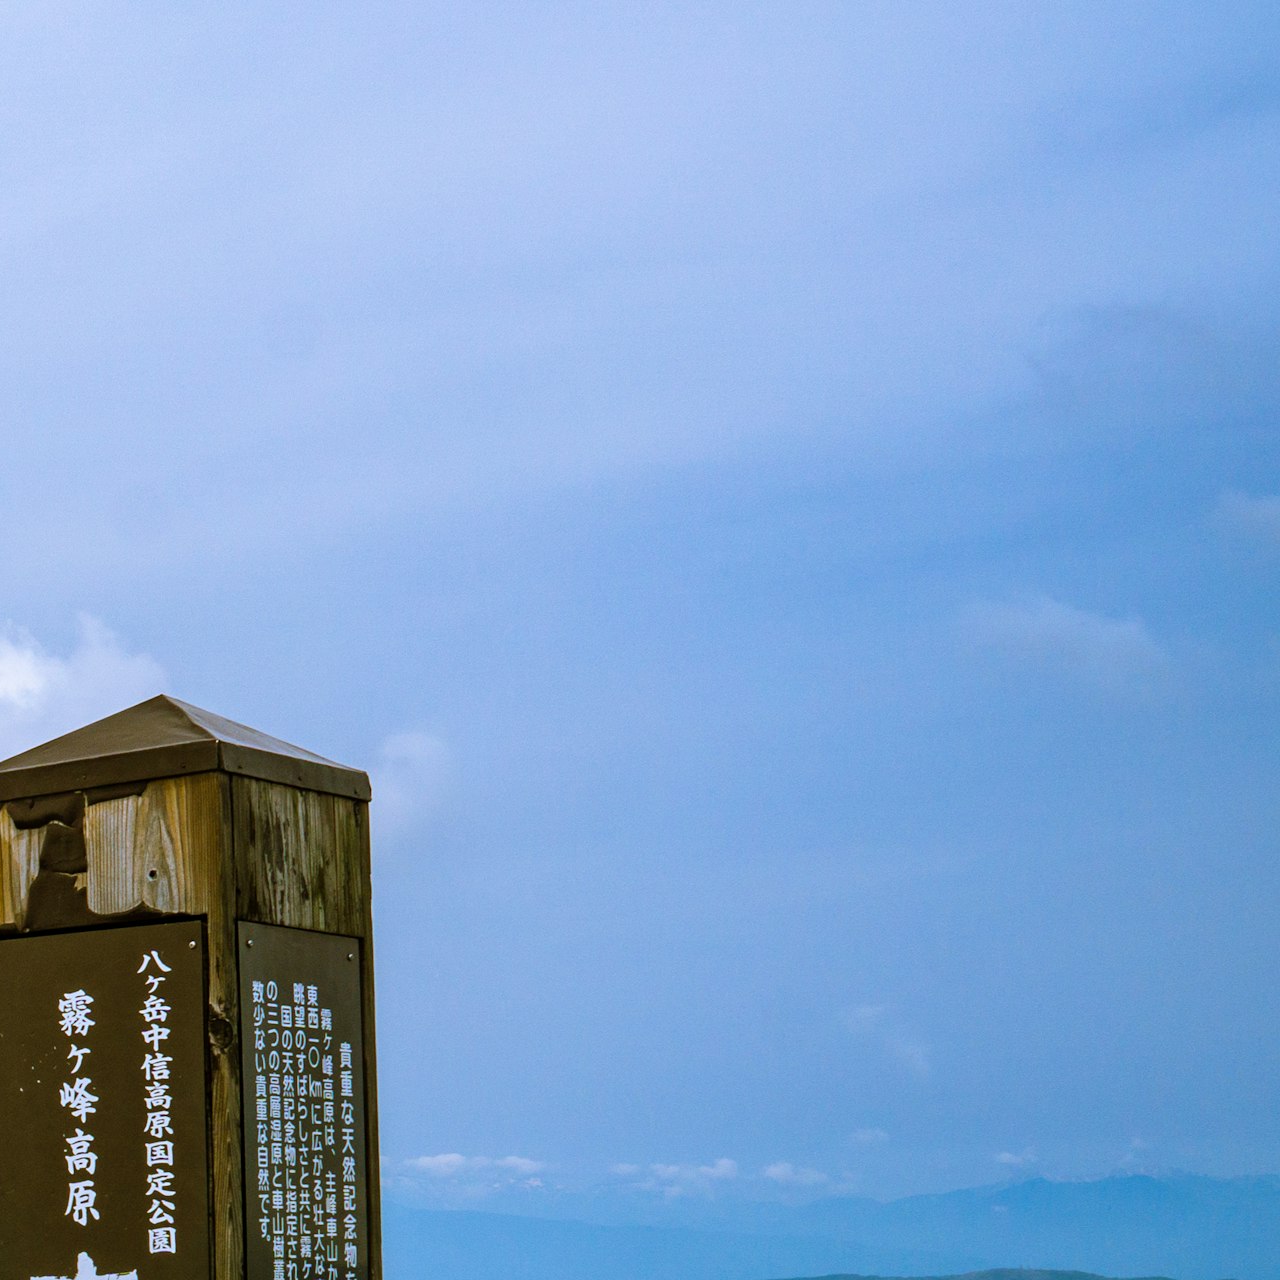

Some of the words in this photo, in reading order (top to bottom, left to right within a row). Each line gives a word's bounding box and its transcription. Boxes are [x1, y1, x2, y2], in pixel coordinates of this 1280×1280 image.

[251, 980, 271, 1242] 数少ない貴重な自然です。
